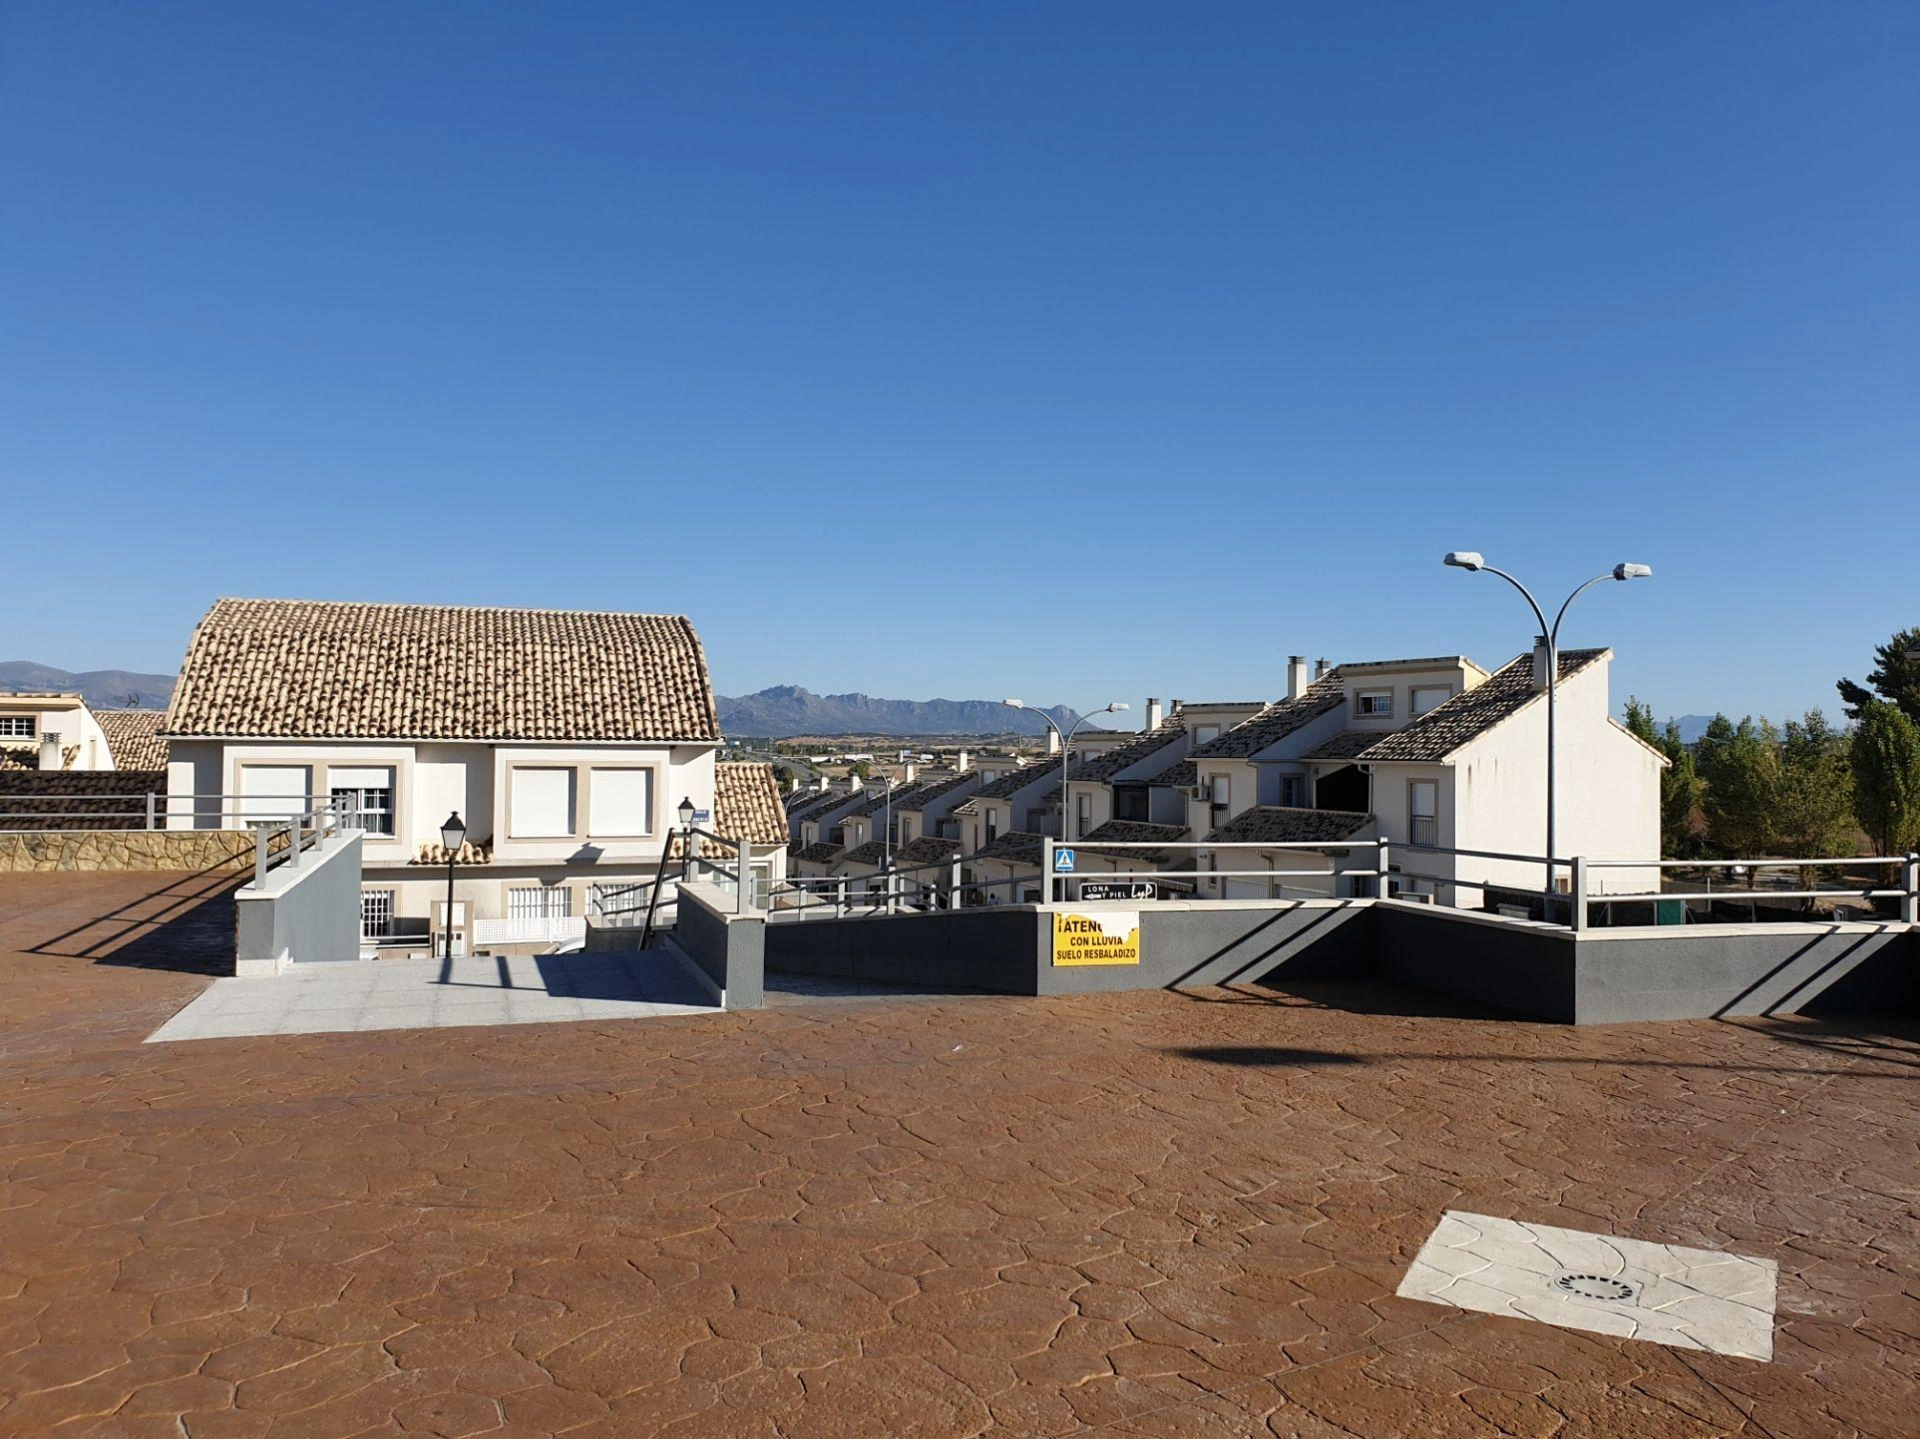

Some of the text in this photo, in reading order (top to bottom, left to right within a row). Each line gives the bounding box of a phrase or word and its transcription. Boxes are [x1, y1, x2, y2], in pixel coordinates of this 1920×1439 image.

[1070, 936, 1123, 946] CON LLUVIA
[1056, 948, 1136, 960] SUELO RESBALADIZO
